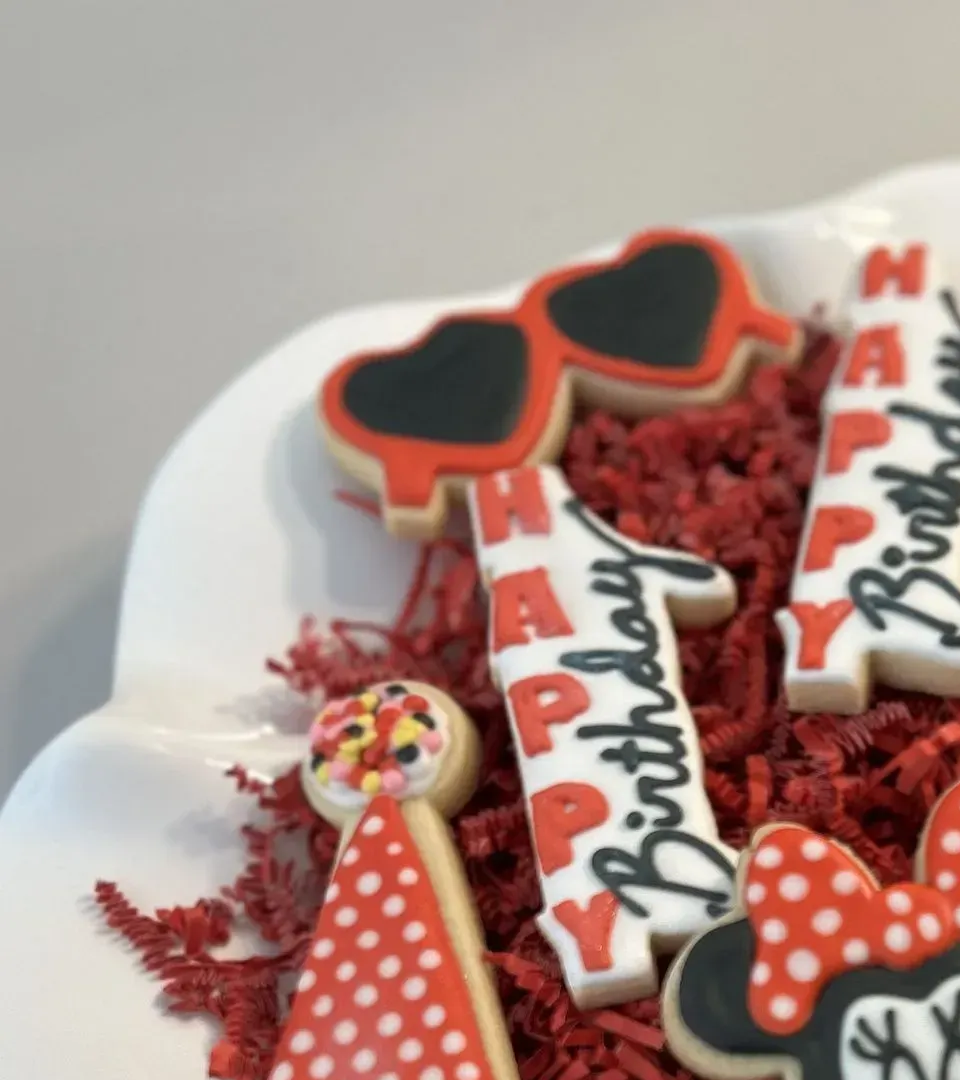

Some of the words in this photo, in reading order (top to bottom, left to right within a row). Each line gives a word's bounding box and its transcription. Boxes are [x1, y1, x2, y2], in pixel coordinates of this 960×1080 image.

[787, 242, 928, 671] HAPPY
[475, 467, 620, 973] HAPPY
[560, 498, 737, 919] Birthday
